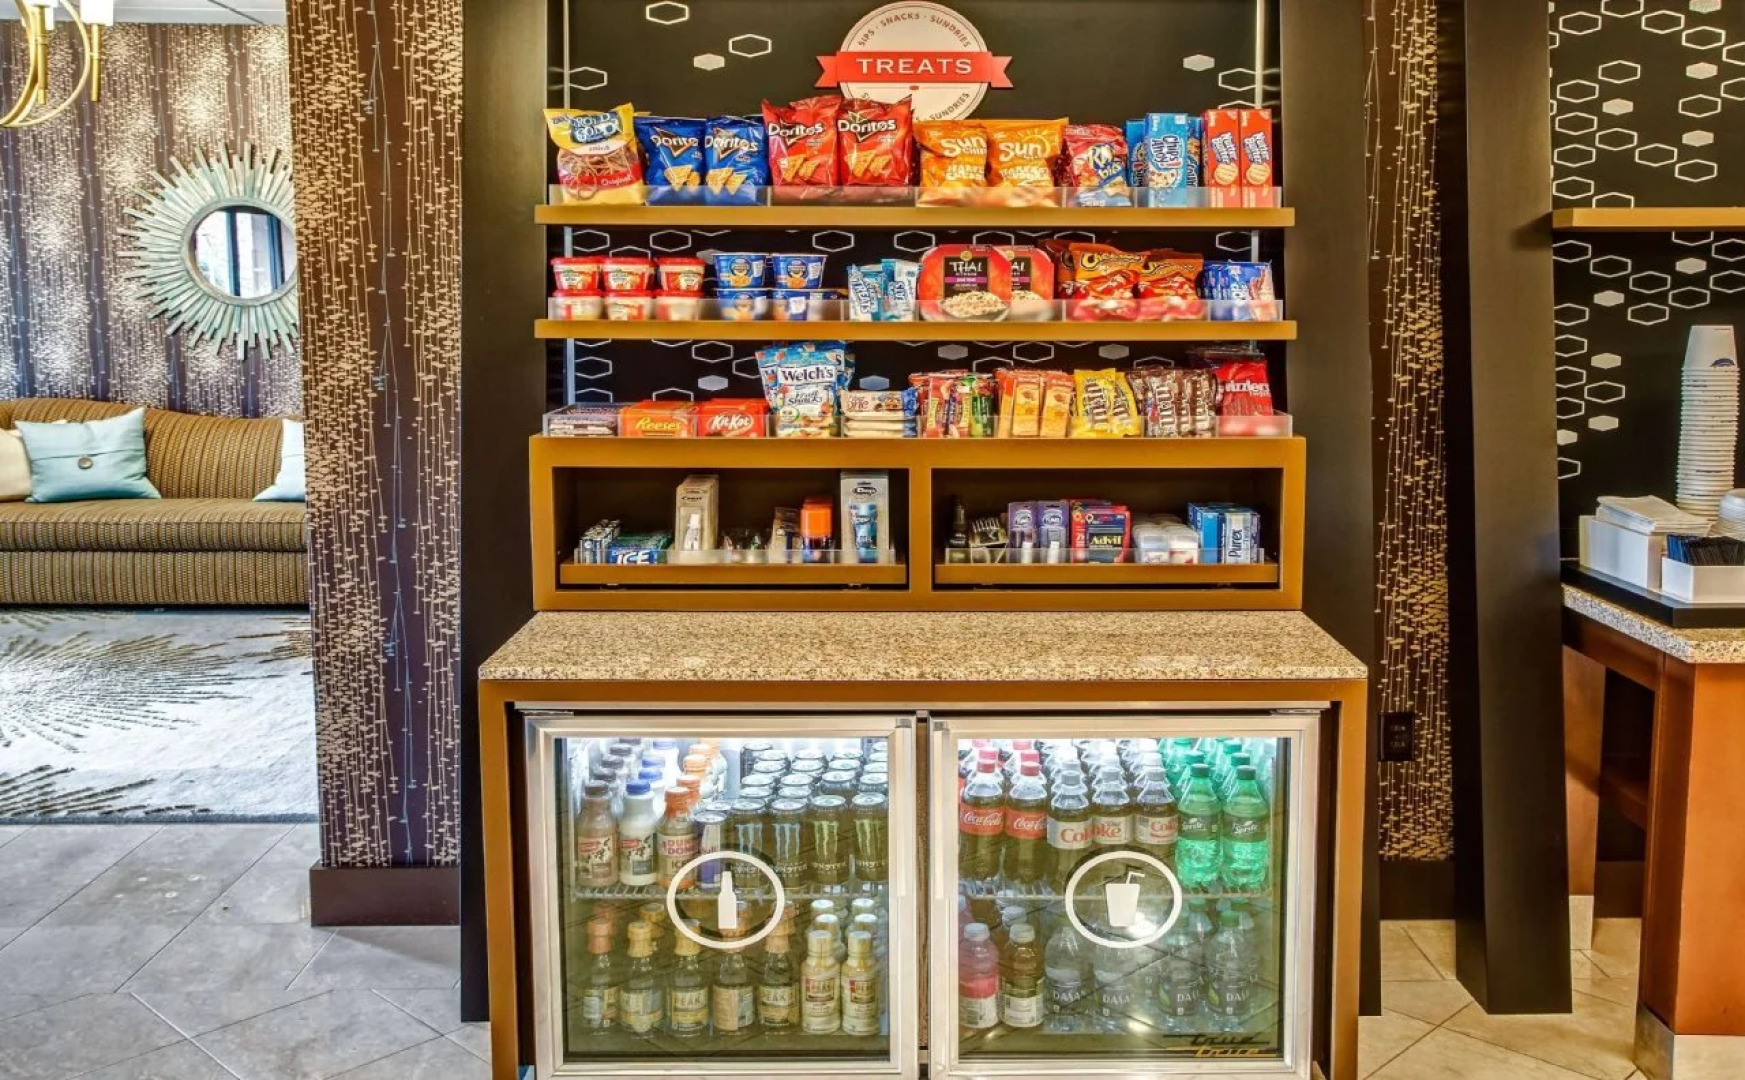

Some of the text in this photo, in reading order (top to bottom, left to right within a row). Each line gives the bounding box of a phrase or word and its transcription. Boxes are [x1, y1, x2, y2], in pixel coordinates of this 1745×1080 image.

[858, 12, 972, 48] SIPS SNACKS SUNDRIES
[855, 58, 972, 75] TREATS
[929, 92, 971, 121] SUNDRIES
[768, 122, 824, 137] Doritos
[837, 119, 897, 133] Doritos
[704, 135, 759, 152] Doritos
[940, 137, 987, 158] Sun
[998, 142, 1042, 162] Sun
[1162, 135, 1180, 162] Chips
[949, 261, 983, 273] THAI
[782, 366, 833, 382] Welch's
[1090, 535, 1122, 545] Advil
[1228, 528, 1244, 558] Purex
[616, 550, 650, 564] ICE
